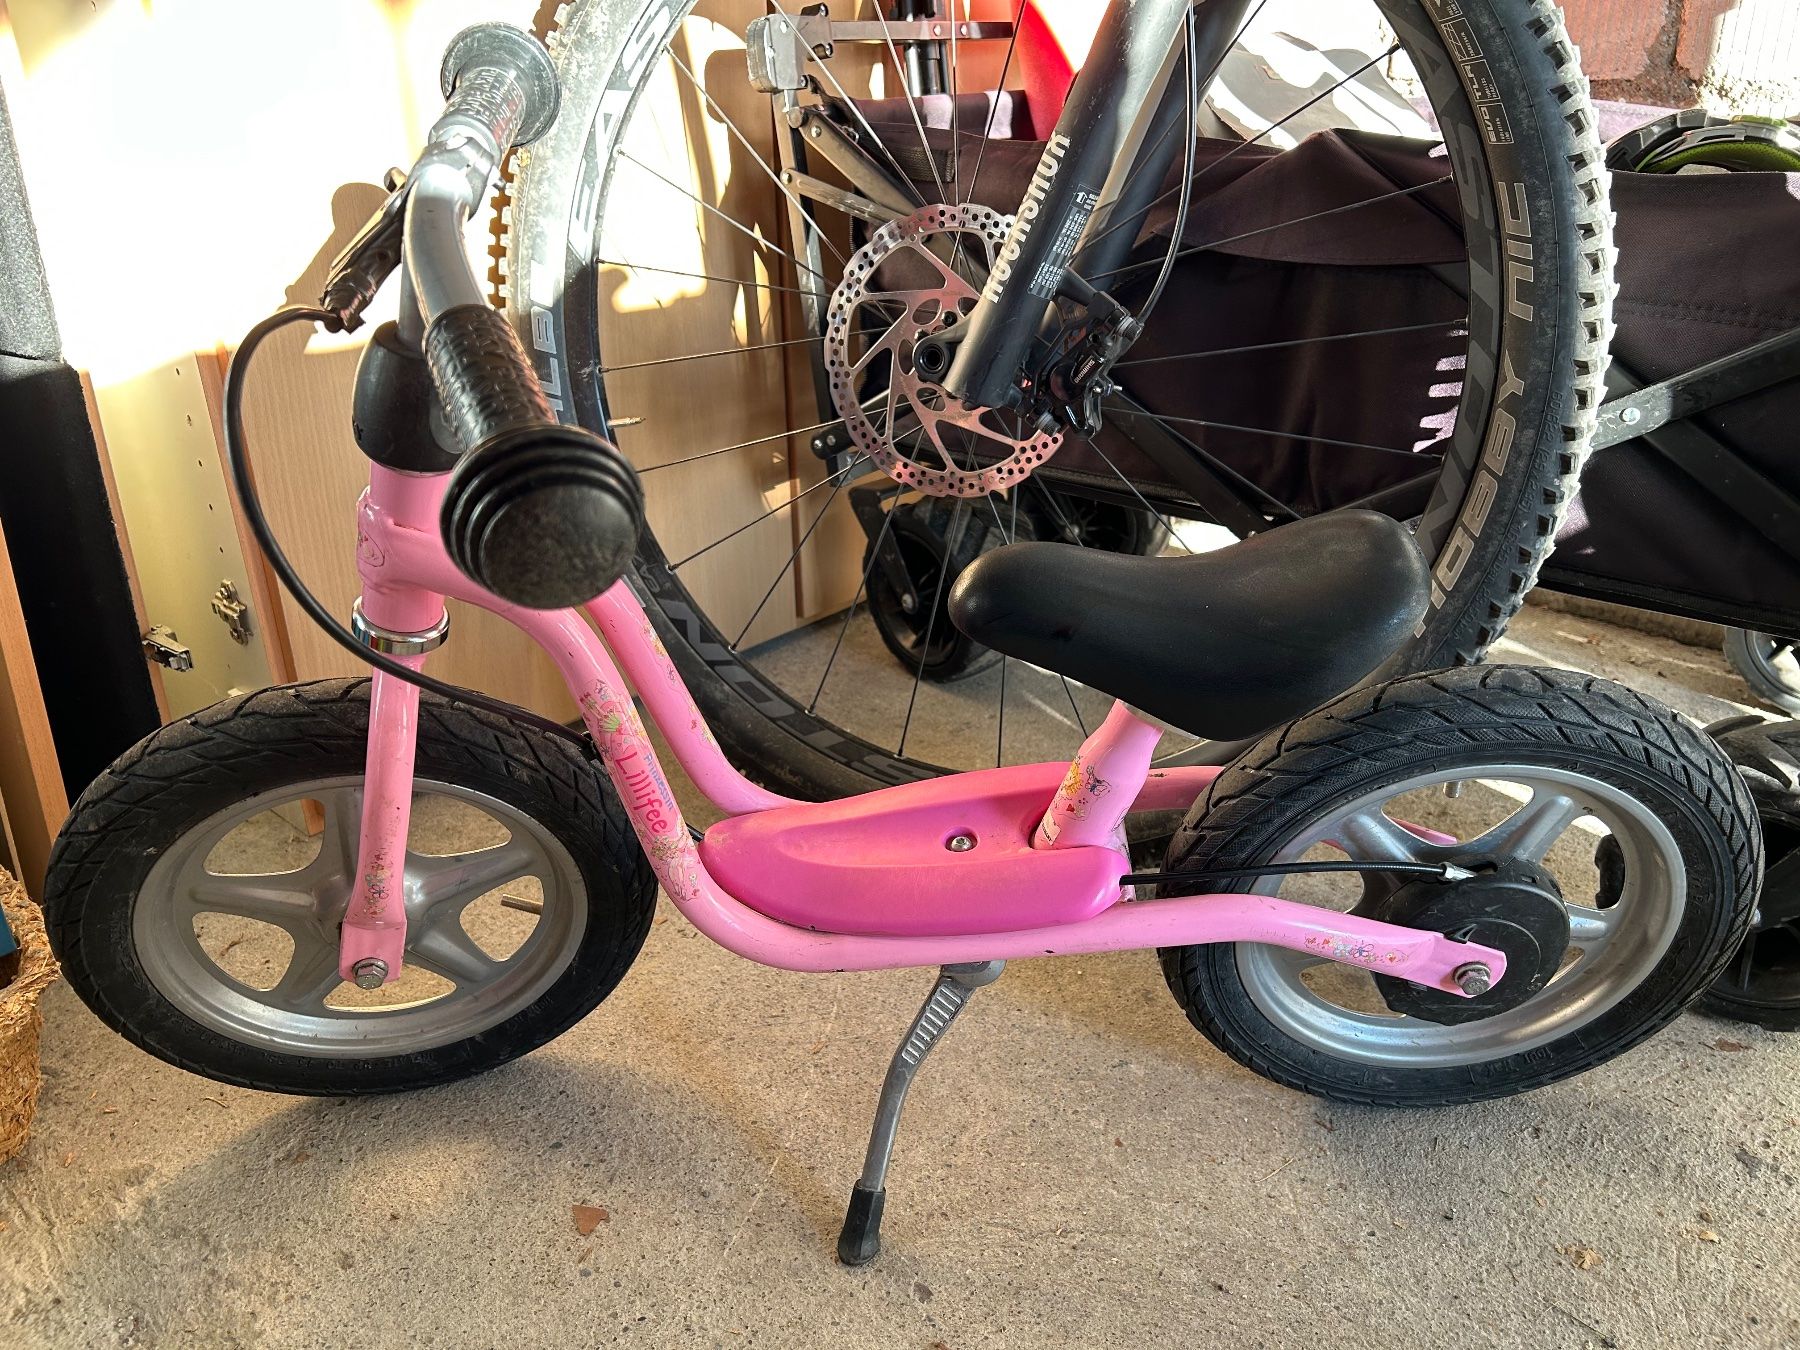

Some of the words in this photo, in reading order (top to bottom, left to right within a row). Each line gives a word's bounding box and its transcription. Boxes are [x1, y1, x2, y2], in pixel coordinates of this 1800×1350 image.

[1464, 65, 1482, 100] TLR
[1481, 106, 1497, 143] EVO
[1498, 181, 1534, 321] NIC
[615, 751, 668, 833] Lillifee
